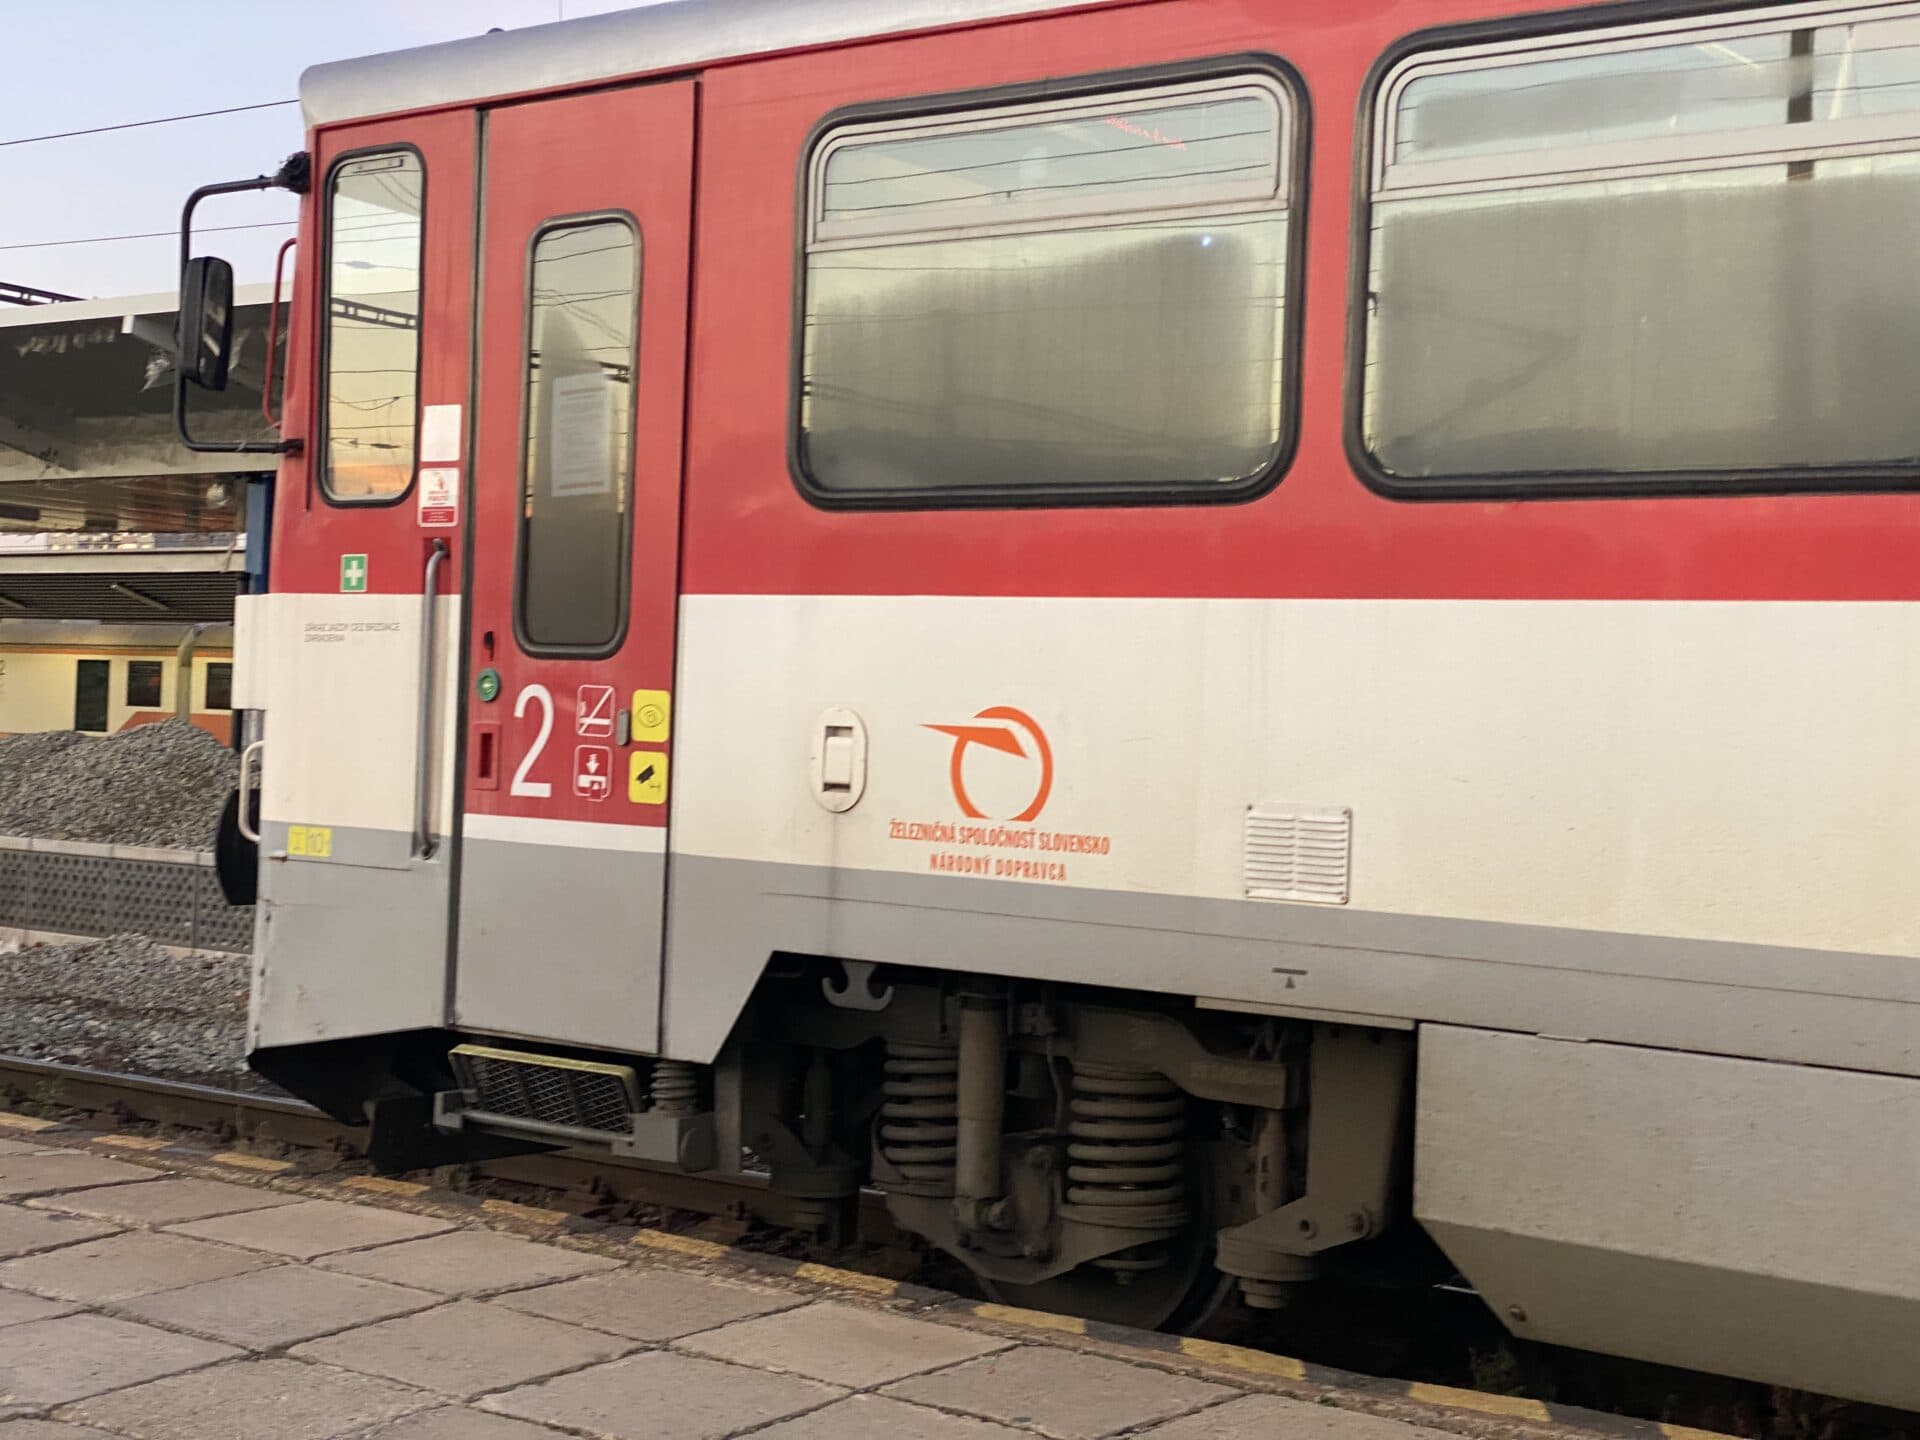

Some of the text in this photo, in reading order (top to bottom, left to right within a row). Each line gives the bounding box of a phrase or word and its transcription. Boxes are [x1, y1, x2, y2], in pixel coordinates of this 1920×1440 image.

[510, 684, 554, 798] 2
[888, 818, 1111, 855] ŽELEZNIČNÁ SPOLOČNOSŤ SLOVENSKO
[930, 852, 1066, 881] NÁRODNÝ DOPRAVCA
